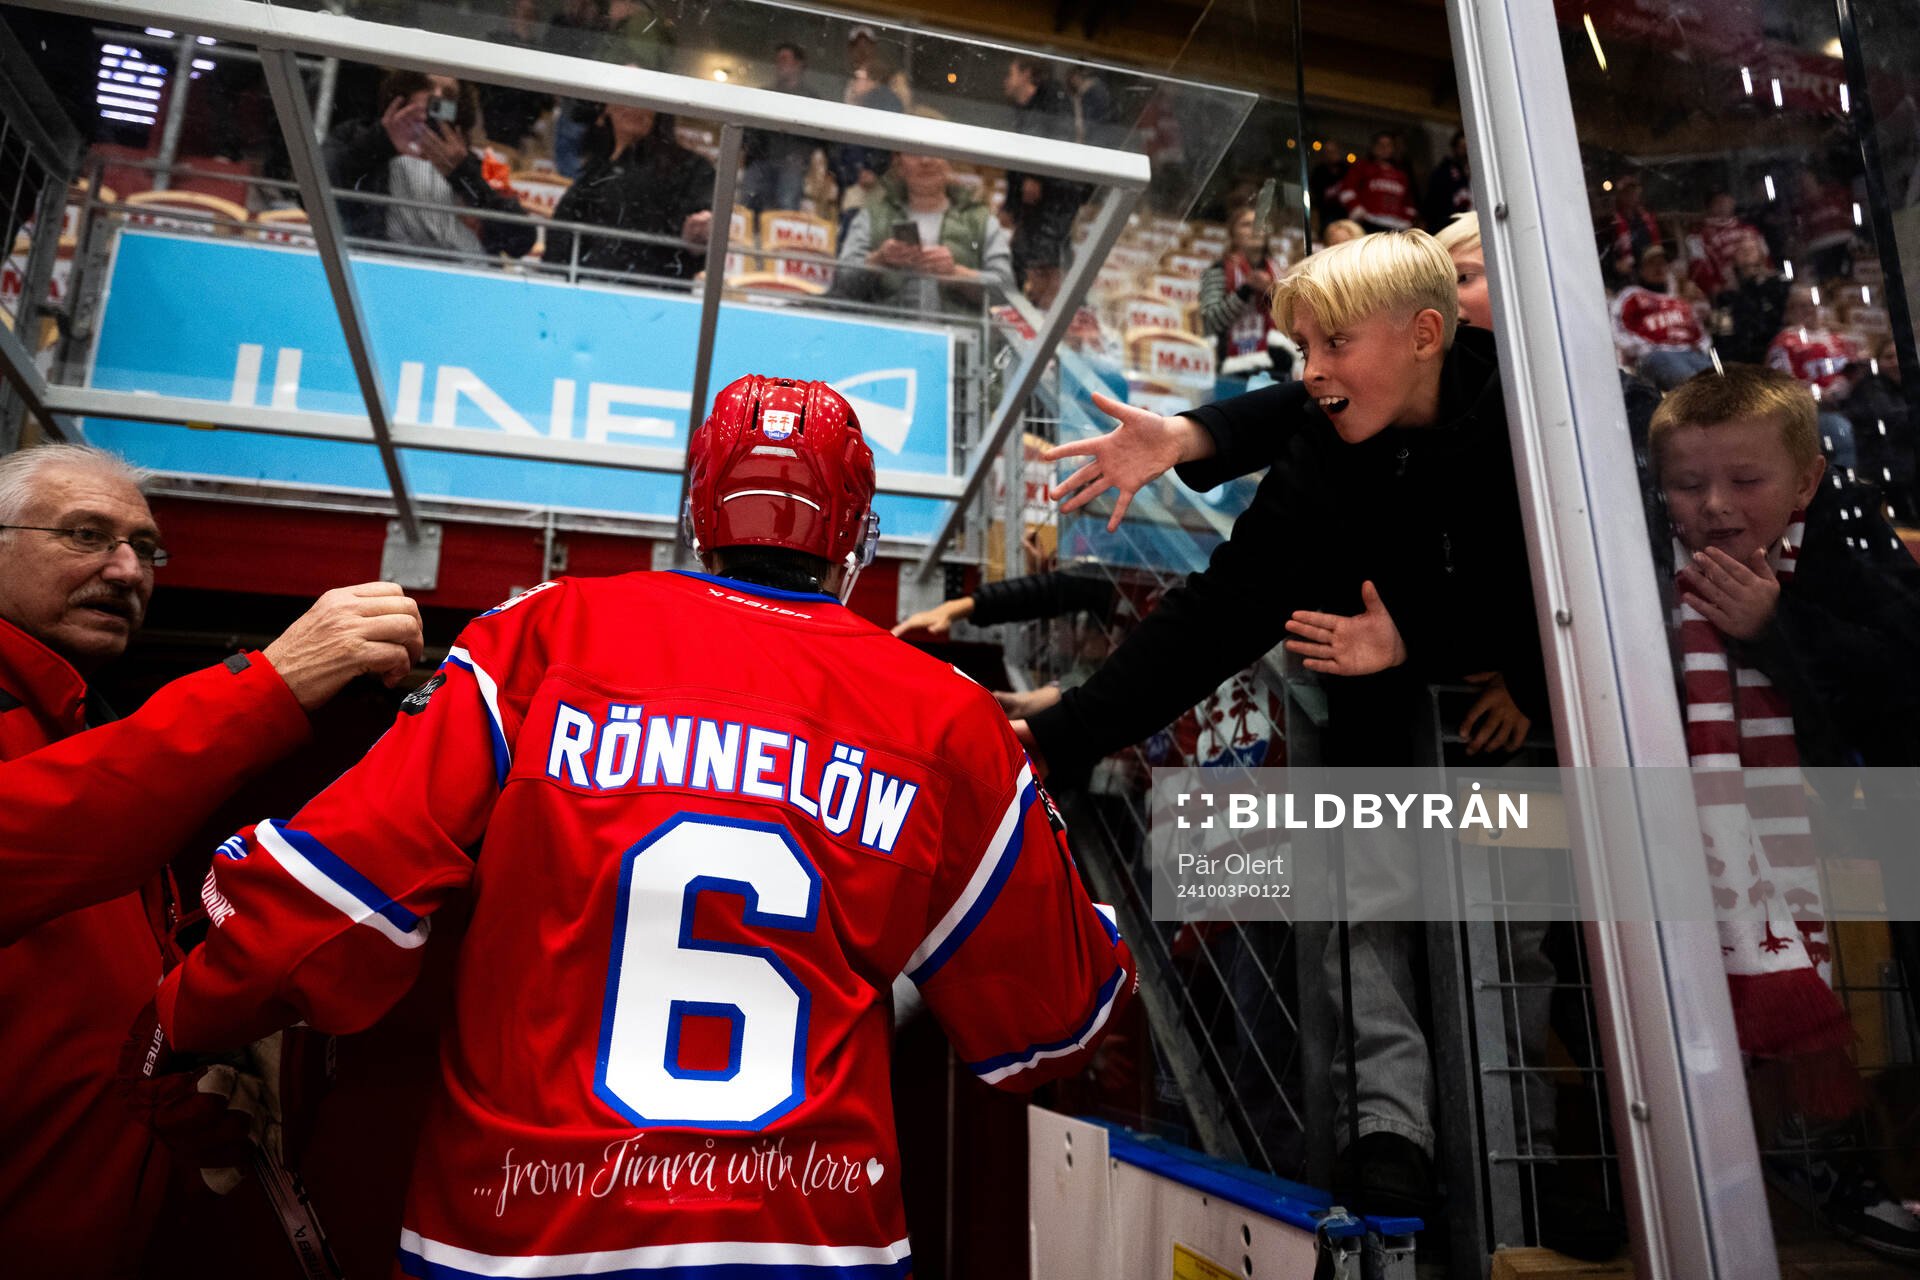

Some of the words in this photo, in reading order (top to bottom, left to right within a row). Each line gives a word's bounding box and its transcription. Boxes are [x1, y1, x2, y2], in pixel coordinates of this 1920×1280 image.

[546, 701, 919, 855] RÖNNELÖW
[595, 811, 821, 1131] 6
[591, 1133, 716, 1197] Timrå
[727, 1136, 797, 1189] with
[802, 1141, 861, 1197] love
